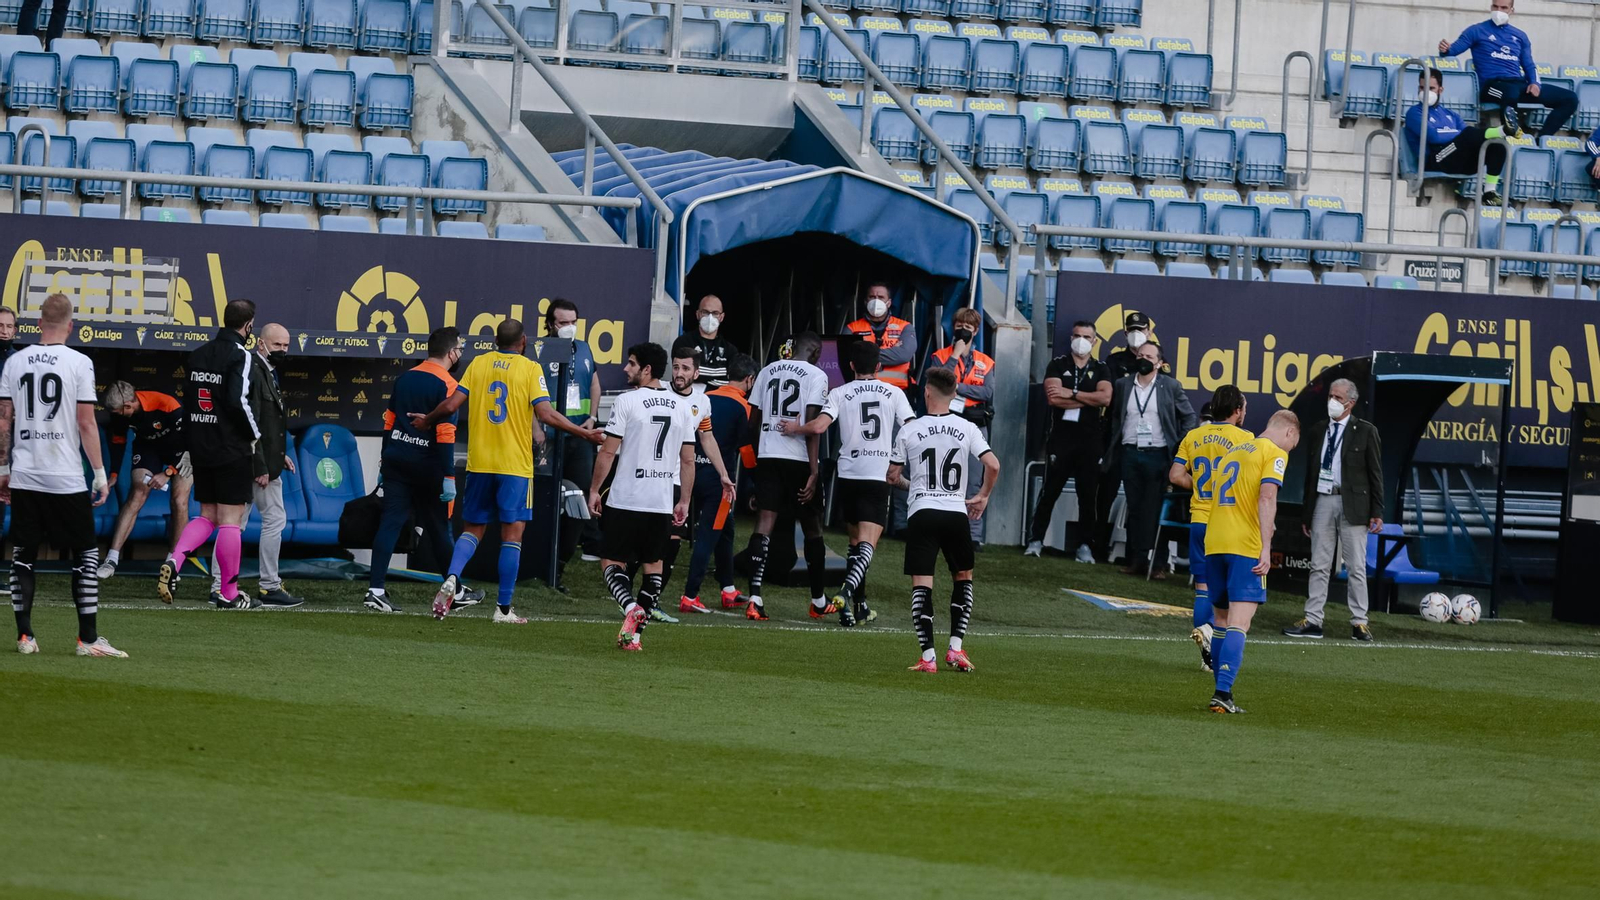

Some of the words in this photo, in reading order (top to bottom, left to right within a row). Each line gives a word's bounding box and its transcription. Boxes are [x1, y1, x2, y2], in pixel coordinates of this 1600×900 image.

[714, 8, 749, 19] dafabet
[863, 20, 900, 30] dafabet
[914, 22, 949, 33] dafabet
[962, 26, 998, 37] dafabet
[1011, 30, 1047, 41] dafabet
[1062, 33, 1097, 44] dafabet
[1109, 36, 1144, 48] dafabet
[1156, 40, 1191, 51] dafabet
[1564, 67, 1598, 77] dafabet
[917, 95, 953, 107] dafabet
[969, 101, 1005, 111] dafabet
[1075, 108, 1111, 119] dafabet
[1127, 112, 1163, 122] dafabet
[1180, 115, 1215, 126] dafabet
[1230, 119, 1265, 130] dafabet
[1546, 138, 1580, 149] dafabet
[991, 178, 1027, 189] dafabet
[1043, 182, 1079, 192] dafabet
[1097, 185, 1133, 196] dafabet
[1149, 188, 1185, 199] dafabet
[1203, 192, 1238, 203] dafabet
[1254, 195, 1290, 206] dafabet
[1307, 198, 1342, 209] dafabet
[1456, 319, 1498, 335] ENSE
[94, 329, 122, 341] LaLiga
[154, 329, 174, 340] CÁDIZ
[184, 330, 210, 341] FÚTBOL
[315, 335, 335, 346] CÁDIZ
[344, 336, 369, 347] FÚTBOL
[473, 340, 493, 350] CÁDIZ
[493, 361, 510, 370] FALI
[769, 363, 808, 379] DIAKHABY
[819, 361, 839, 370] VAR
[17, 372, 63, 422] 19
[766, 378, 801, 419] 12
[844, 393, 856, 402] G.
[855, 384, 893, 400] PAULISTA
[487, 380, 508, 425] 3
[643, 398, 677, 410] GUEDES
[860, 400, 881, 442] 5
[917, 431, 928, 442] A.
[928, 424, 966, 442] BLANCO
[1421, 417, 1498, 443] NERGÍA
[399, 432, 430, 447] Libertex
[650, 416, 671, 461] 7
[1193, 440, 1202, 450] A.
[1203, 434, 1234, 450] ESPINO
[919, 447, 962, 493] 16
[1218, 460, 1241, 507] 2
